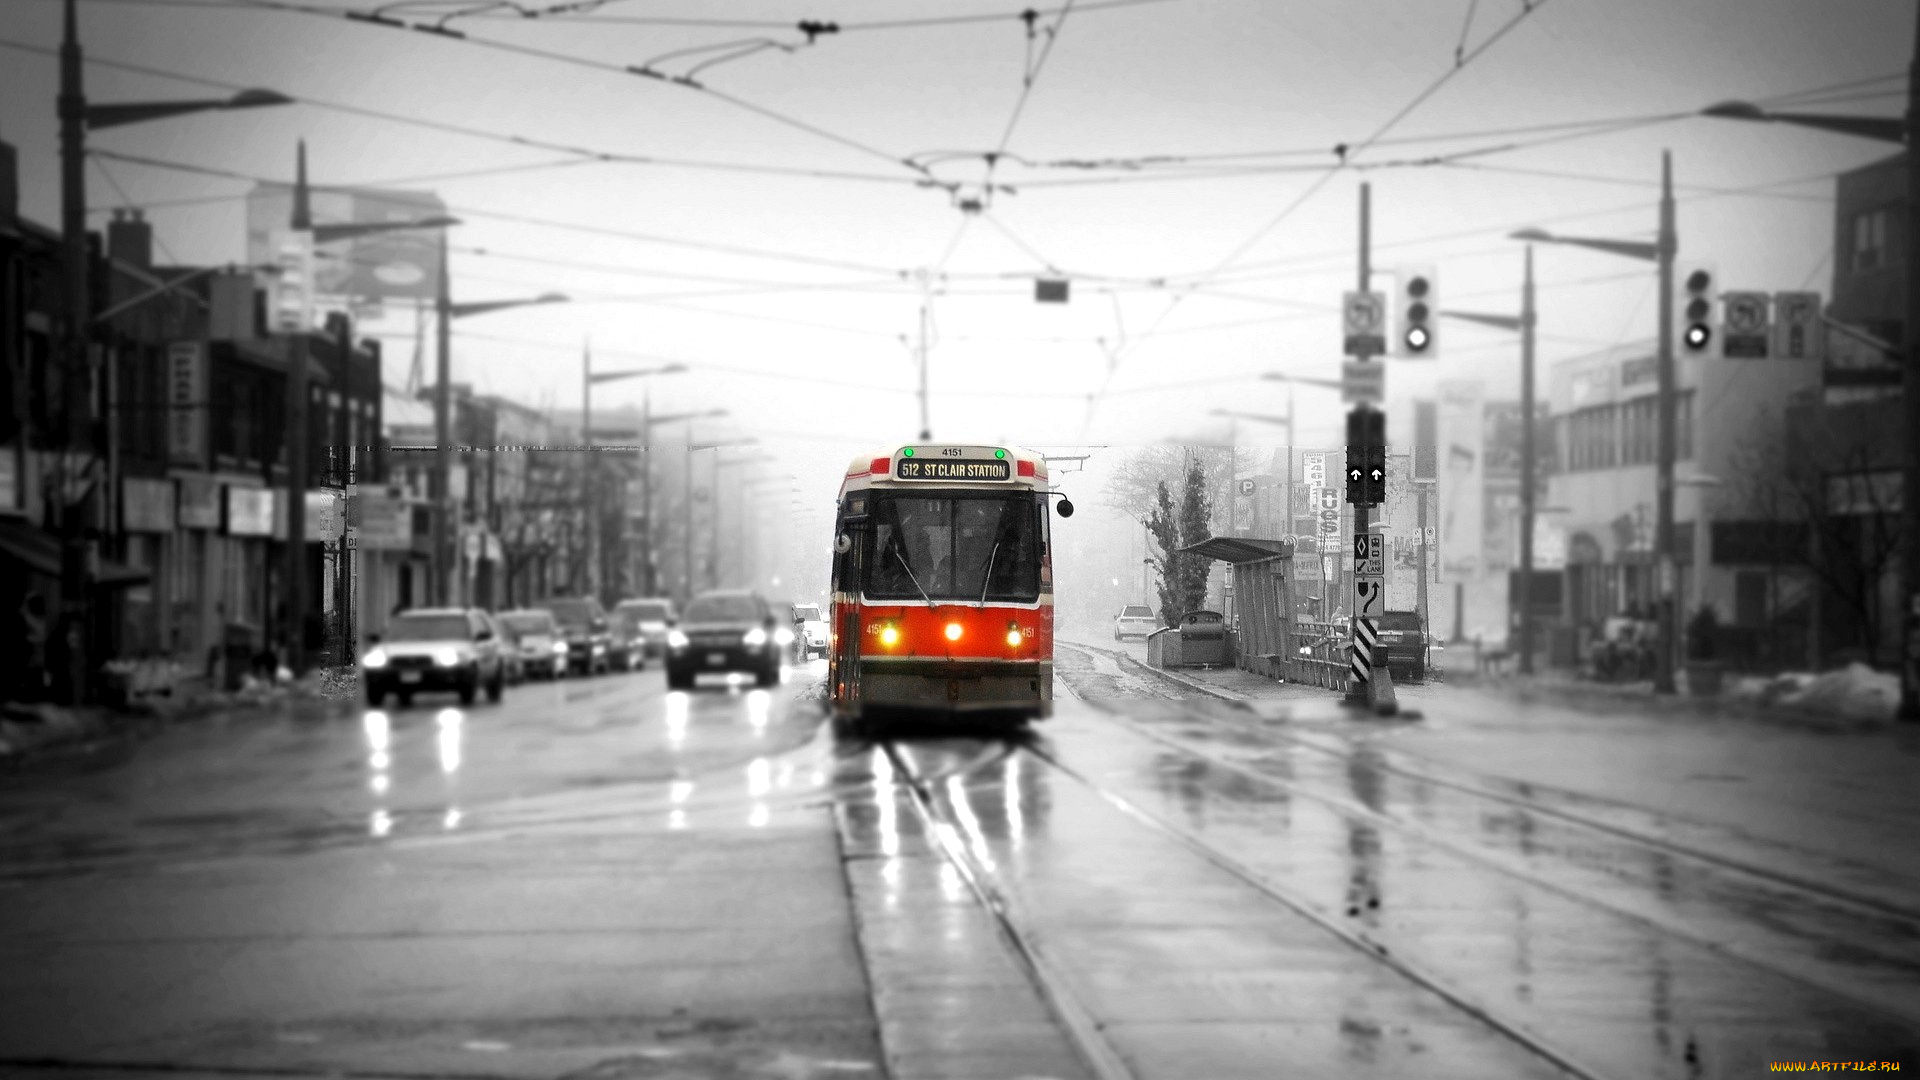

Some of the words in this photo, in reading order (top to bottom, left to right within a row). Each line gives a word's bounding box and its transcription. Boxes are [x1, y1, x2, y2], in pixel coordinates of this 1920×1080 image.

[942, 448, 962, 457] 4151
[902, 463, 919, 477] 512
[924, 463, 937, 477] ST
[938, 463, 966, 477] CLAIR
[967, 464, 1006, 478] STATION
[1242, 481, 1254, 492] P
[866, 623, 882, 635] 4151
[1022, 626, 1035, 639] 4151
